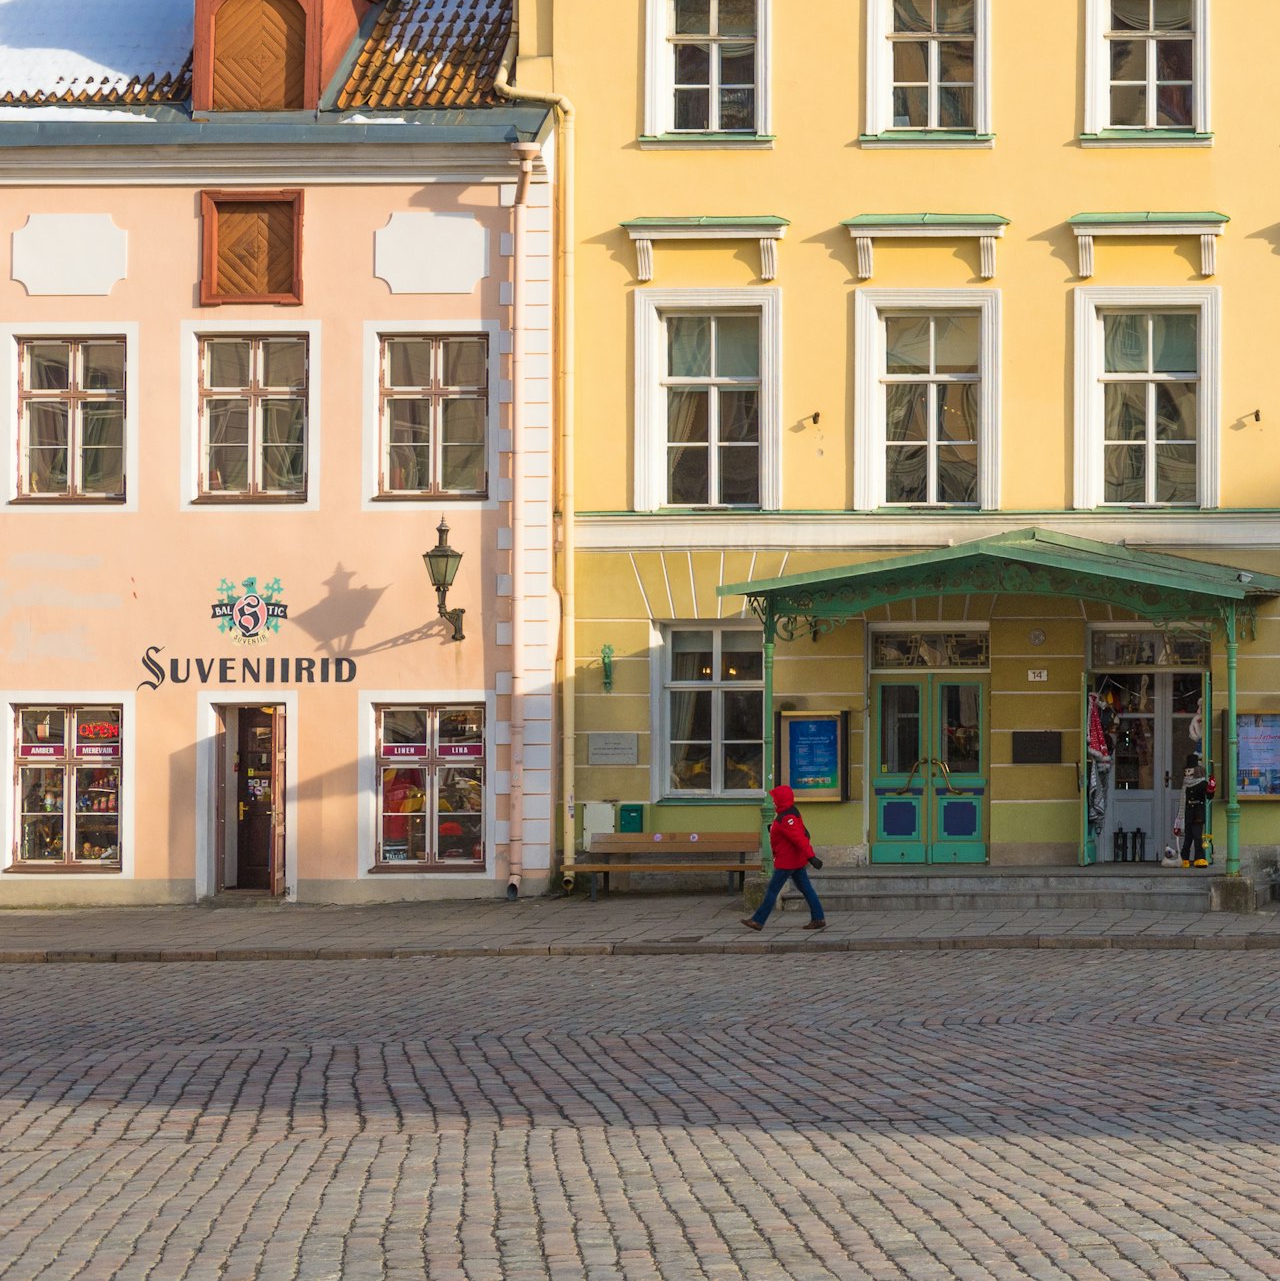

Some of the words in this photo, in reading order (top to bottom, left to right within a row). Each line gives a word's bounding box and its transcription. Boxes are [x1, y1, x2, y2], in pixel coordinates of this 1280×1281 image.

[214, 605, 233, 616] BAL
[267, 605, 285, 616] TIC
[233, 633, 267, 646] SUVENIIR
[136, 645, 357, 692] SUVENIIRID
[1032, 671, 1042, 679] 14
[79, 722, 119, 739] OPEN
